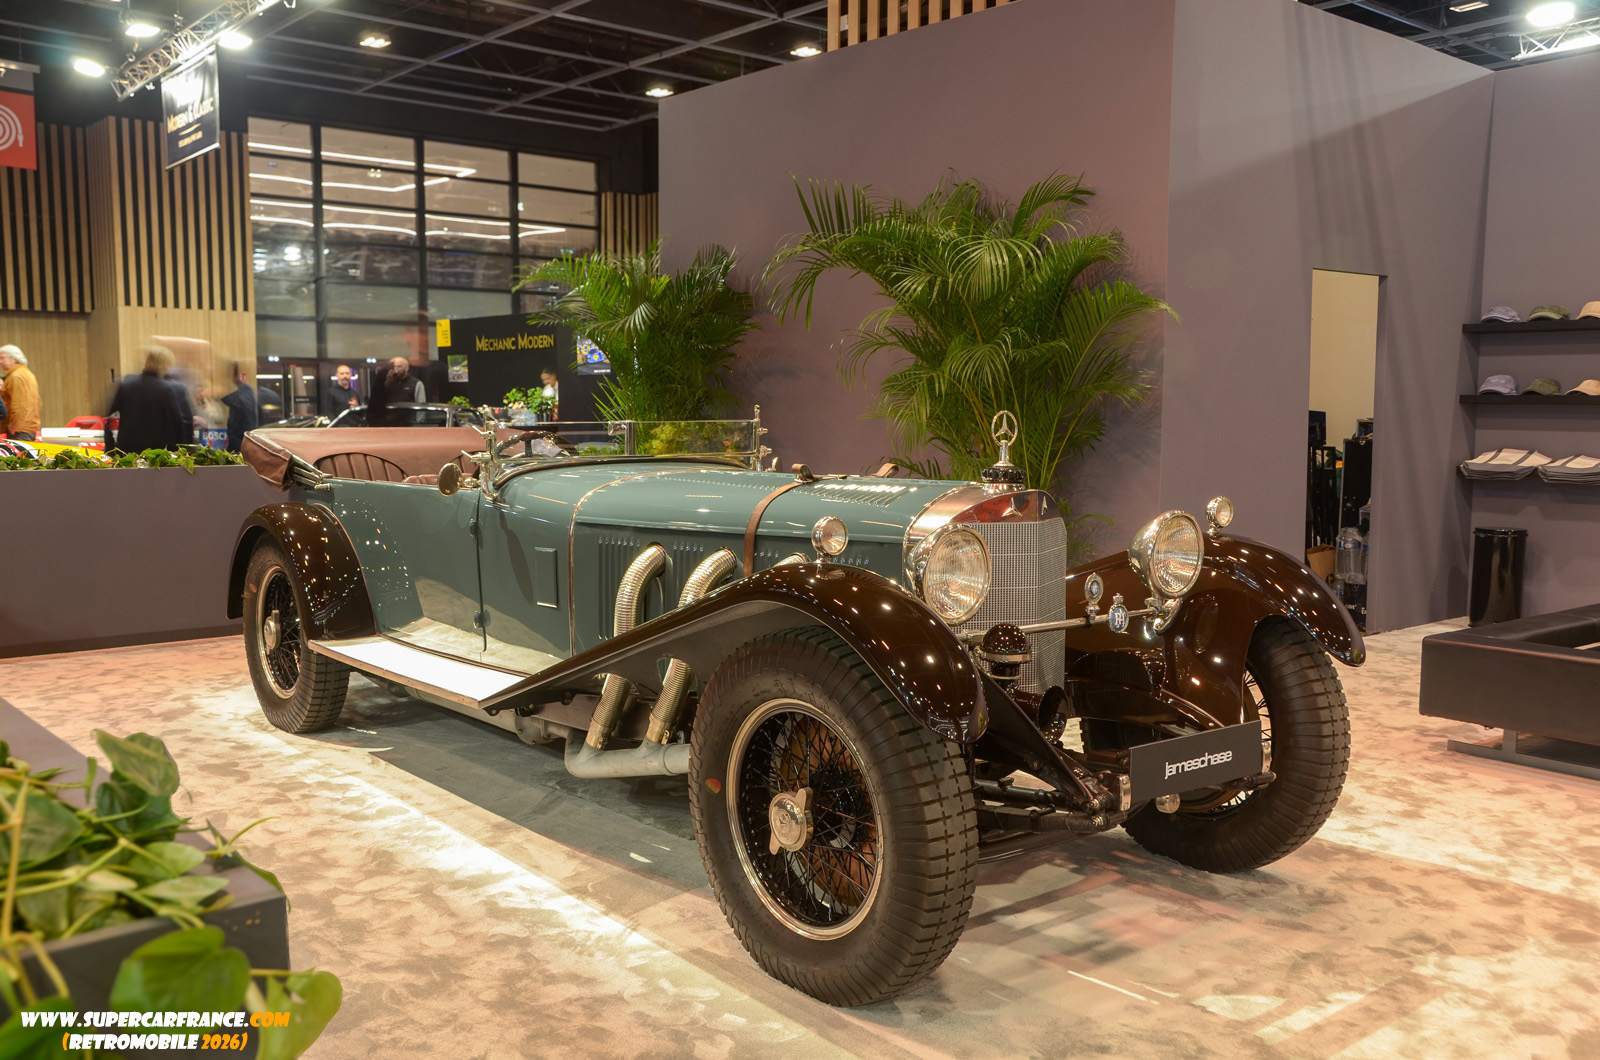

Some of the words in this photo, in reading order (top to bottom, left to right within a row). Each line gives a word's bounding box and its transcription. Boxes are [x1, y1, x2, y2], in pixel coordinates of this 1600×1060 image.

[475, 334, 516, 352] MECHANIC
[518, 331, 555, 350] MODERN
[1164, 750, 1232, 780] jameschase
